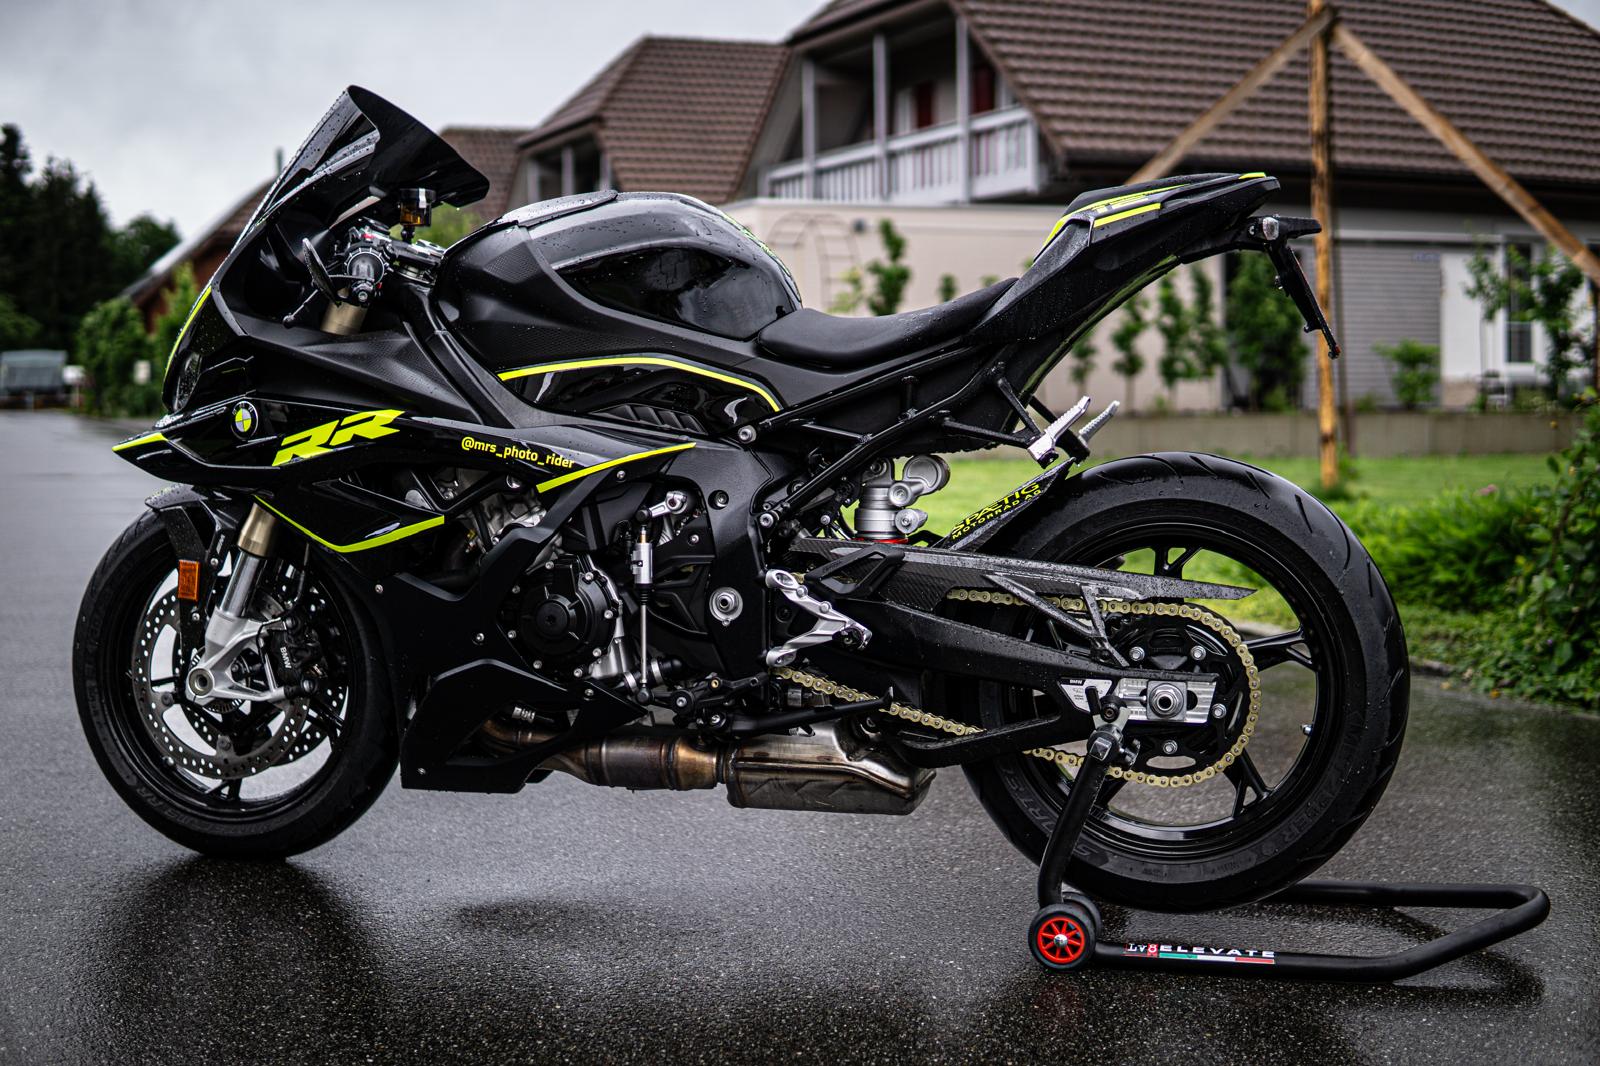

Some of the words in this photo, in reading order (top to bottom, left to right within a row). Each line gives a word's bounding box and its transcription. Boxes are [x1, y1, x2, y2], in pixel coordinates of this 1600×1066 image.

[272, 409, 405, 466] RR
[461, 436, 575, 469] @mrs_photo_rider
[952, 499, 1021, 540] MOTORRAD
[279, 646, 293, 669] BMW
[1159, 945, 1275, 958] ELEVATE
